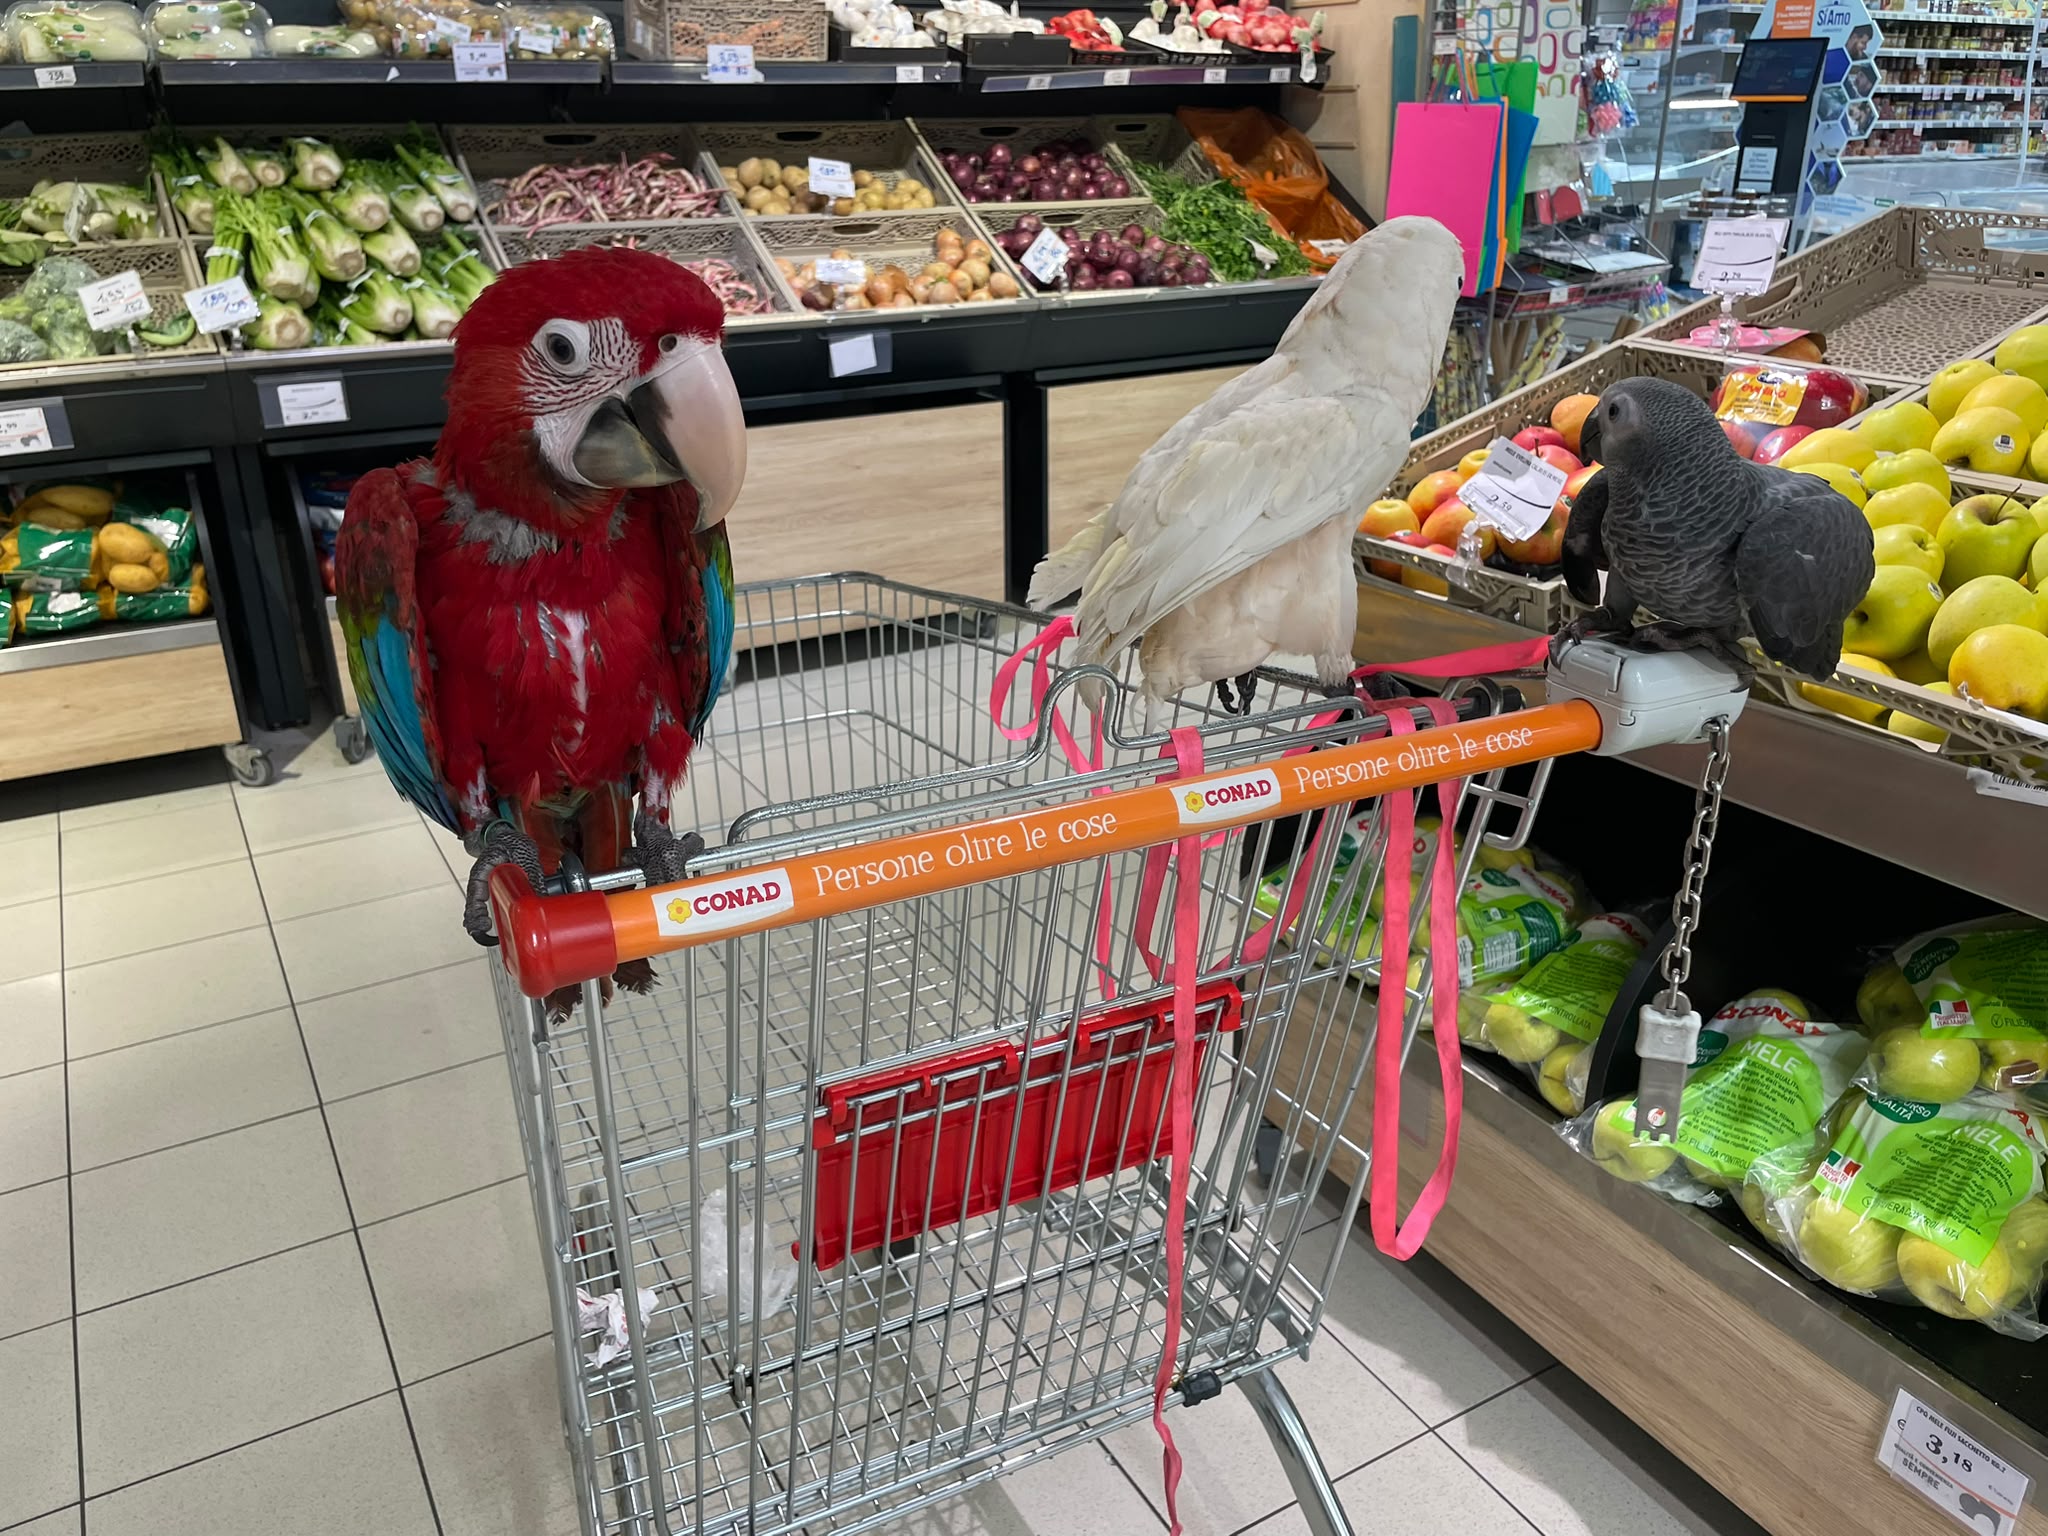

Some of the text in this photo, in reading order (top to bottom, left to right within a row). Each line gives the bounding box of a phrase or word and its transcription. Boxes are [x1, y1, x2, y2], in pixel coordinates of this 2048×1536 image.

[1204, 726, 1533, 807] CONAD Persone oltre le cose
[693, 812, 1117, 916] CONAD Persone oltre le cose
[1740, 1040, 1802, 1073] MELE
[1925, 1433, 1974, 1473] 3,18
[1928, 1415, 1944, 1430] MELE
[1944, 1425, 1957, 1439] FUJI
[1957, 1434, 1991, 1463] SACCHETTO
[1902, 1457, 1941, 1490] SEMPRE
